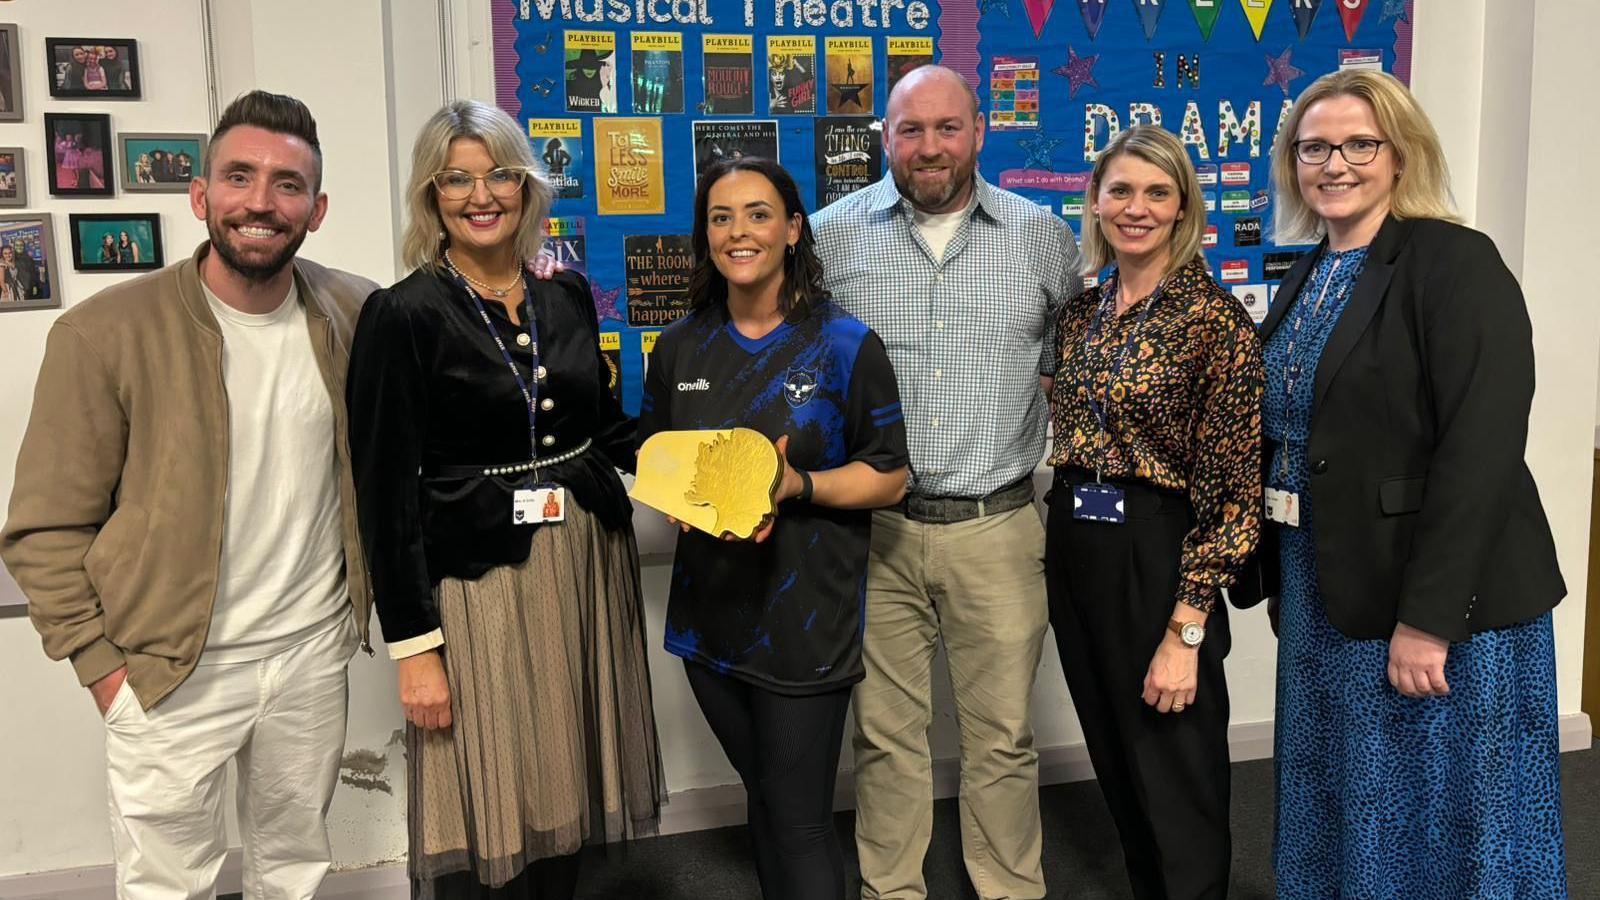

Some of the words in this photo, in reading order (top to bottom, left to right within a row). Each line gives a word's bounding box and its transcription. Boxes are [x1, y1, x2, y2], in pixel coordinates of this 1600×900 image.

[742, 0, 930, 29] Theatre
[567, 34, 613, 44] PLAYBILL
[633, 35, 680, 44] PLAYBILL
[705, 38, 750, 47] PLAYBILL
[769, 40, 813, 48] PLAYBILL
[889, 41, 931, 49] PLAYBILL
[1153, 51, 1200, 88] IN
[791, 90, 812, 108] GIRL
[532, 123, 578, 131] PLAYBILL
[824, 134, 870, 151] THING
[610, 148, 648, 166] LESS
[548, 176, 579, 187] atilda
[607, 166, 649, 187] Smile
[611, 185, 649, 198] MORE
[1234, 223, 1260, 232] RADA
[627, 255, 653, 269] THE
[657, 255, 692, 269] ROOM
[640, 272, 681, 286] where
[655, 295, 667, 307] IT
